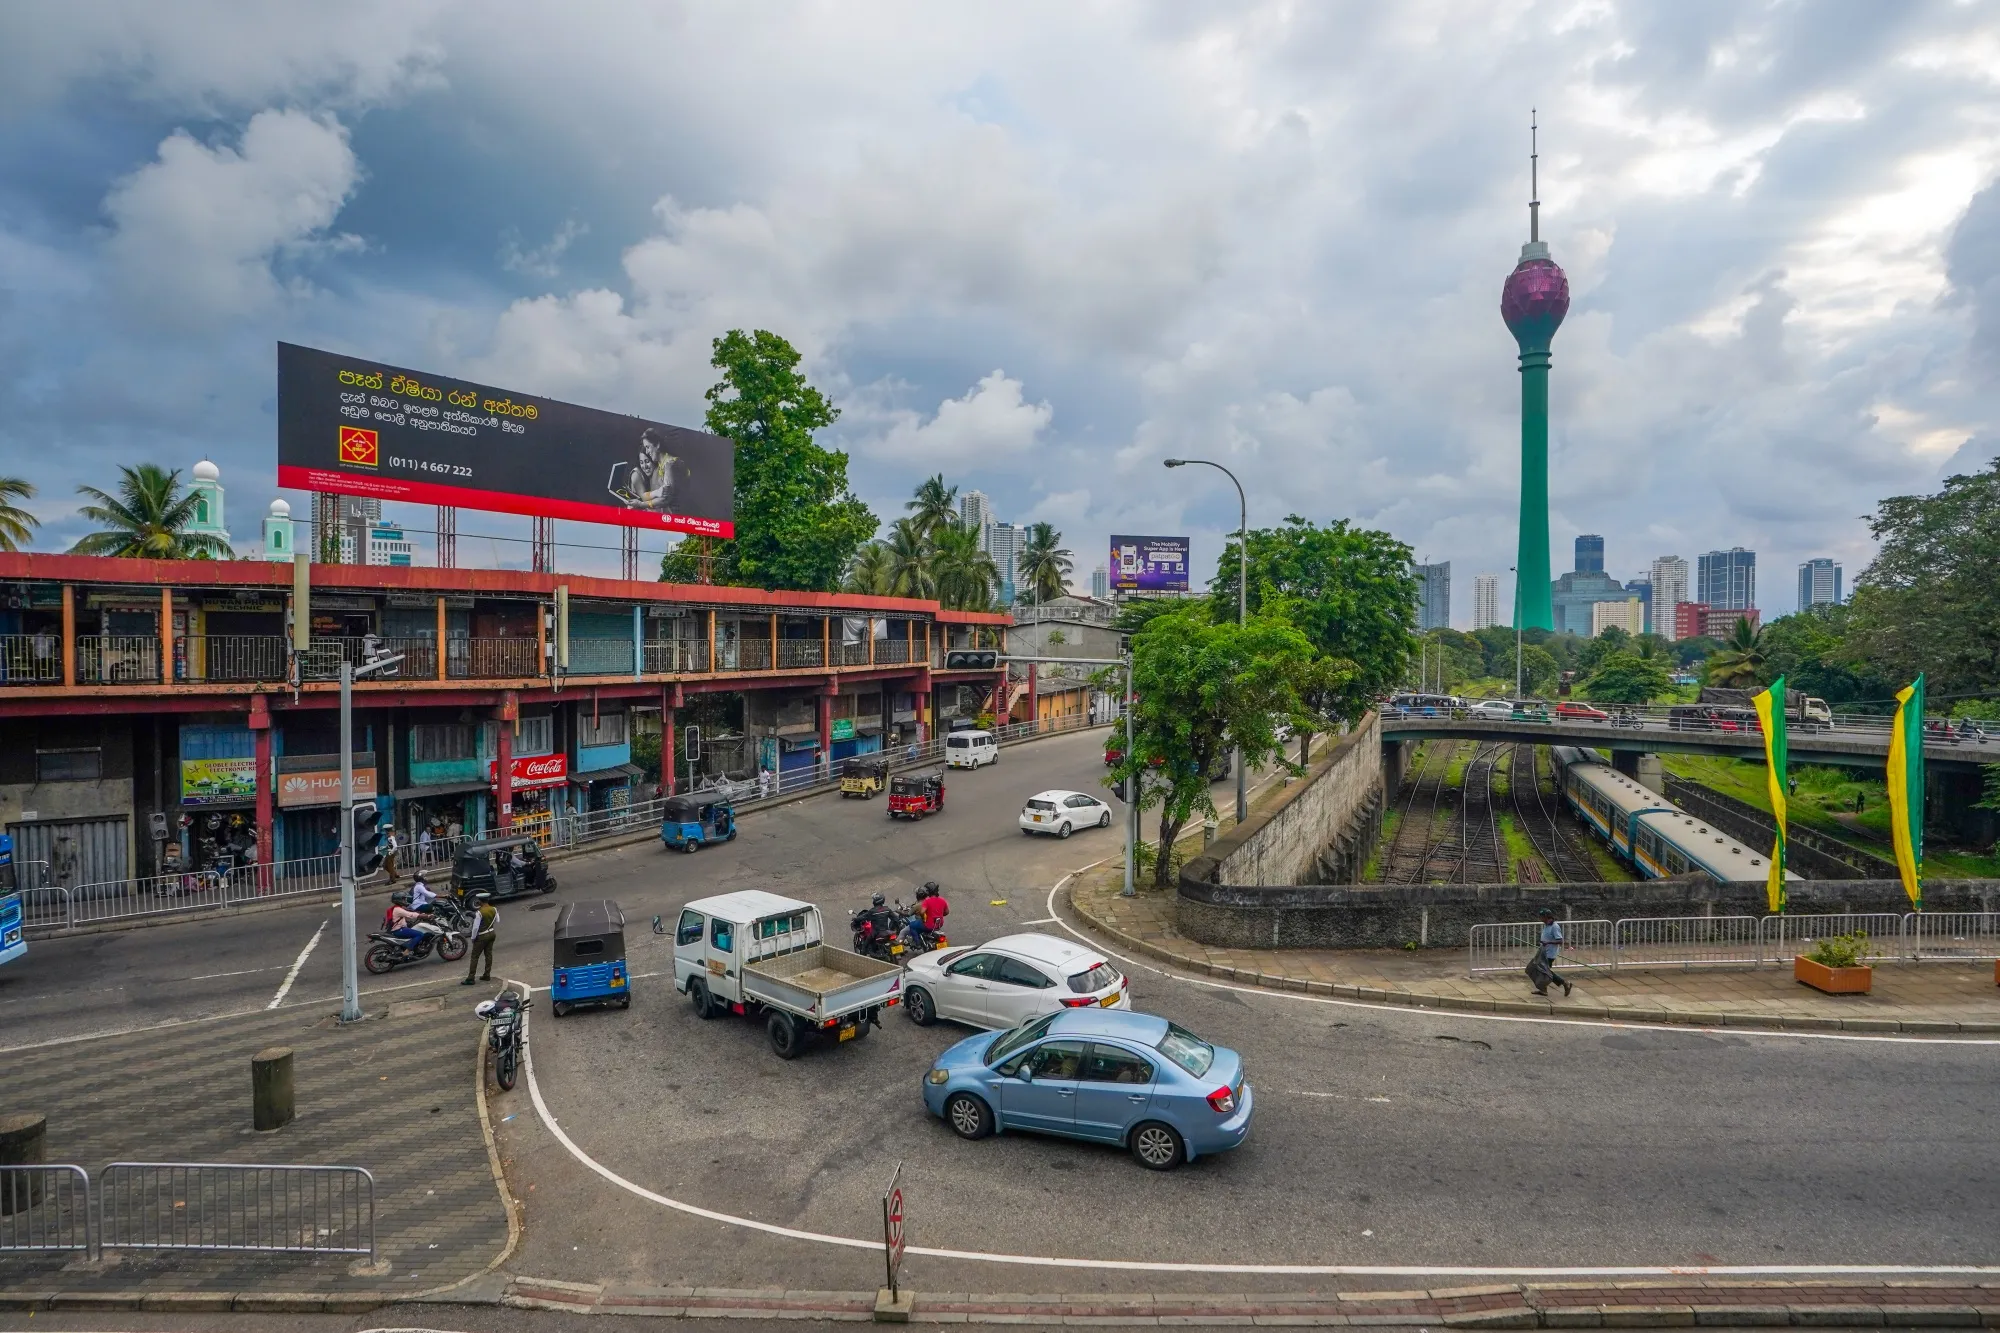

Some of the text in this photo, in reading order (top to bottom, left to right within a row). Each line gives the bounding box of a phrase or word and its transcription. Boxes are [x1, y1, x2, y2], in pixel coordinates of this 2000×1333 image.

[339, 370, 383, 390] පෑන්
[448, 390, 476, 408] රන්
[484, 398, 538, 420] අත්තම
[340, 392, 365, 403] දැන්
[370, 396, 398, 409] ඔබට
[404, 403, 438, 417] ඉහළම
[340, 404, 369, 418] අඩුම
[410, 417, 476, 436] අනුපාතිකයට
[389, 456, 418, 470] (011)
[420, 461, 427, 471] 4
[430, 462, 450, 474] 667
[452, 465, 473, 477] 222
